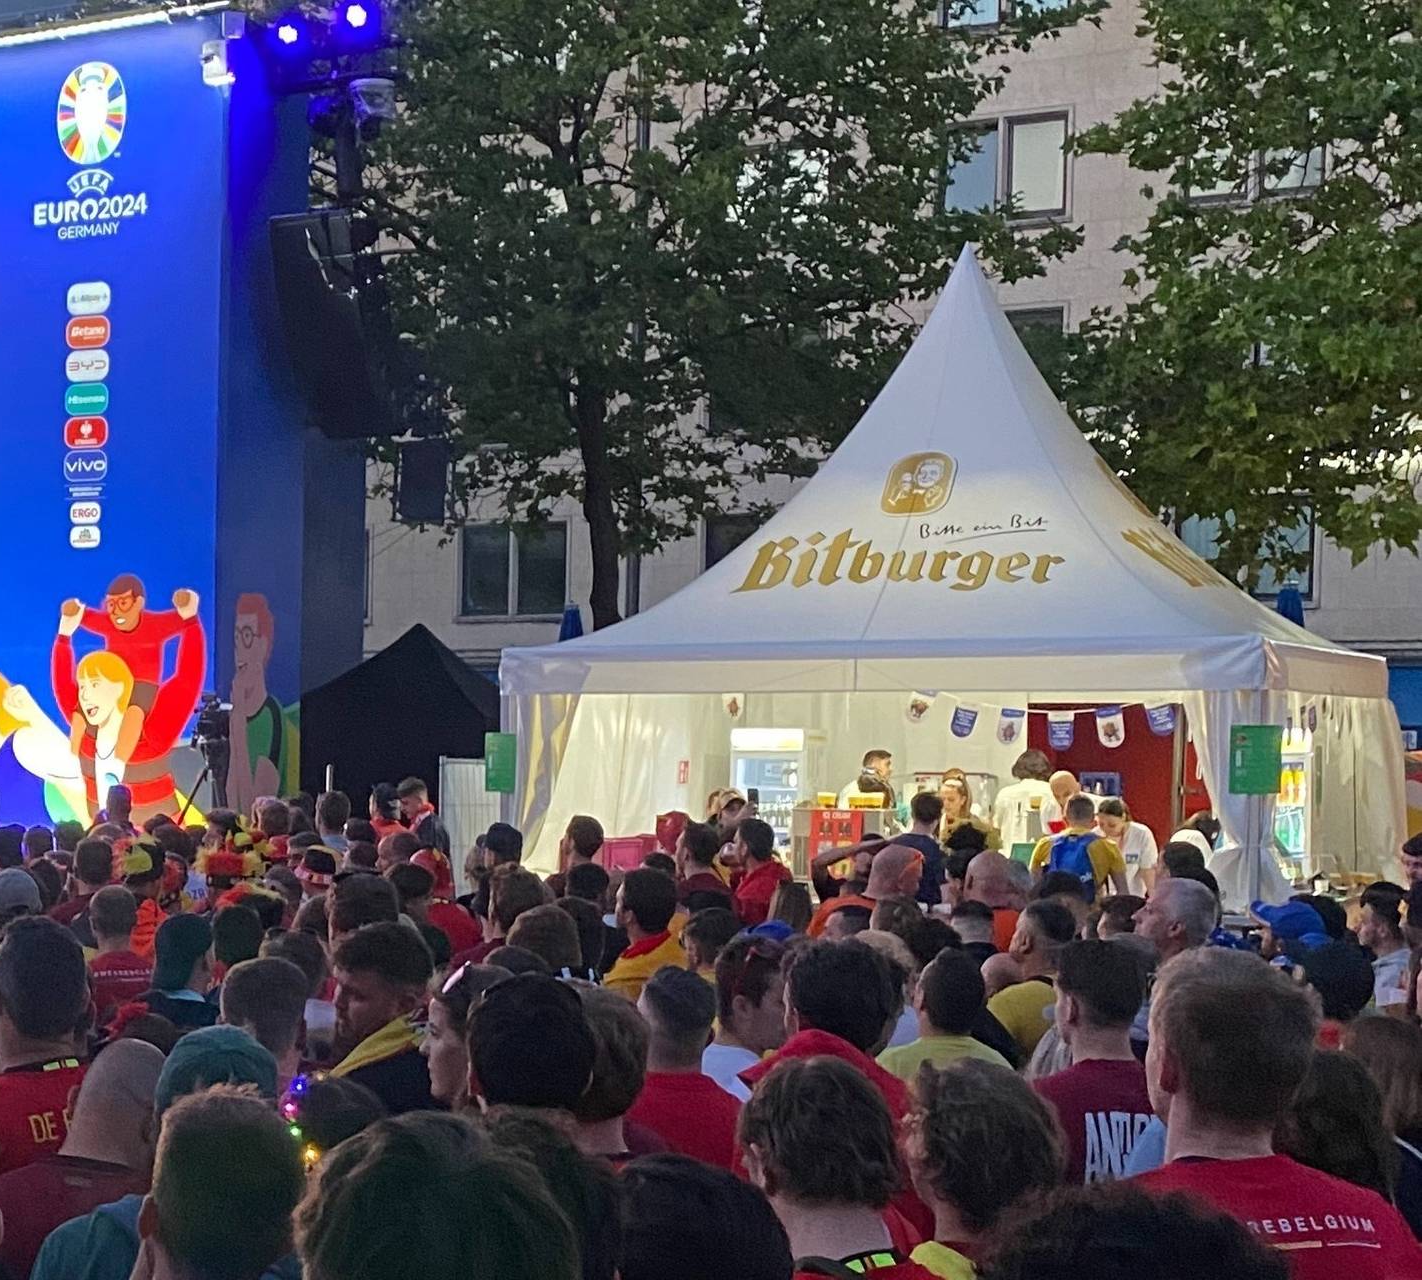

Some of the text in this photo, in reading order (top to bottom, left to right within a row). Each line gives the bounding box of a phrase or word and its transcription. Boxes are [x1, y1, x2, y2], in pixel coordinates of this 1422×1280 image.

[69, 173, 110, 194] UEFA
[33, 193, 148, 226] EURO2024
[57, 222, 120, 240] GERMANY
[66, 458, 106, 472] vivo
[72, 508, 98, 518] ERGO
[730, 528, 1065, 592] Bitburger
[28, 1111, 60, 1143] DE
[1246, 1214, 1376, 1234] REBELGIUM
